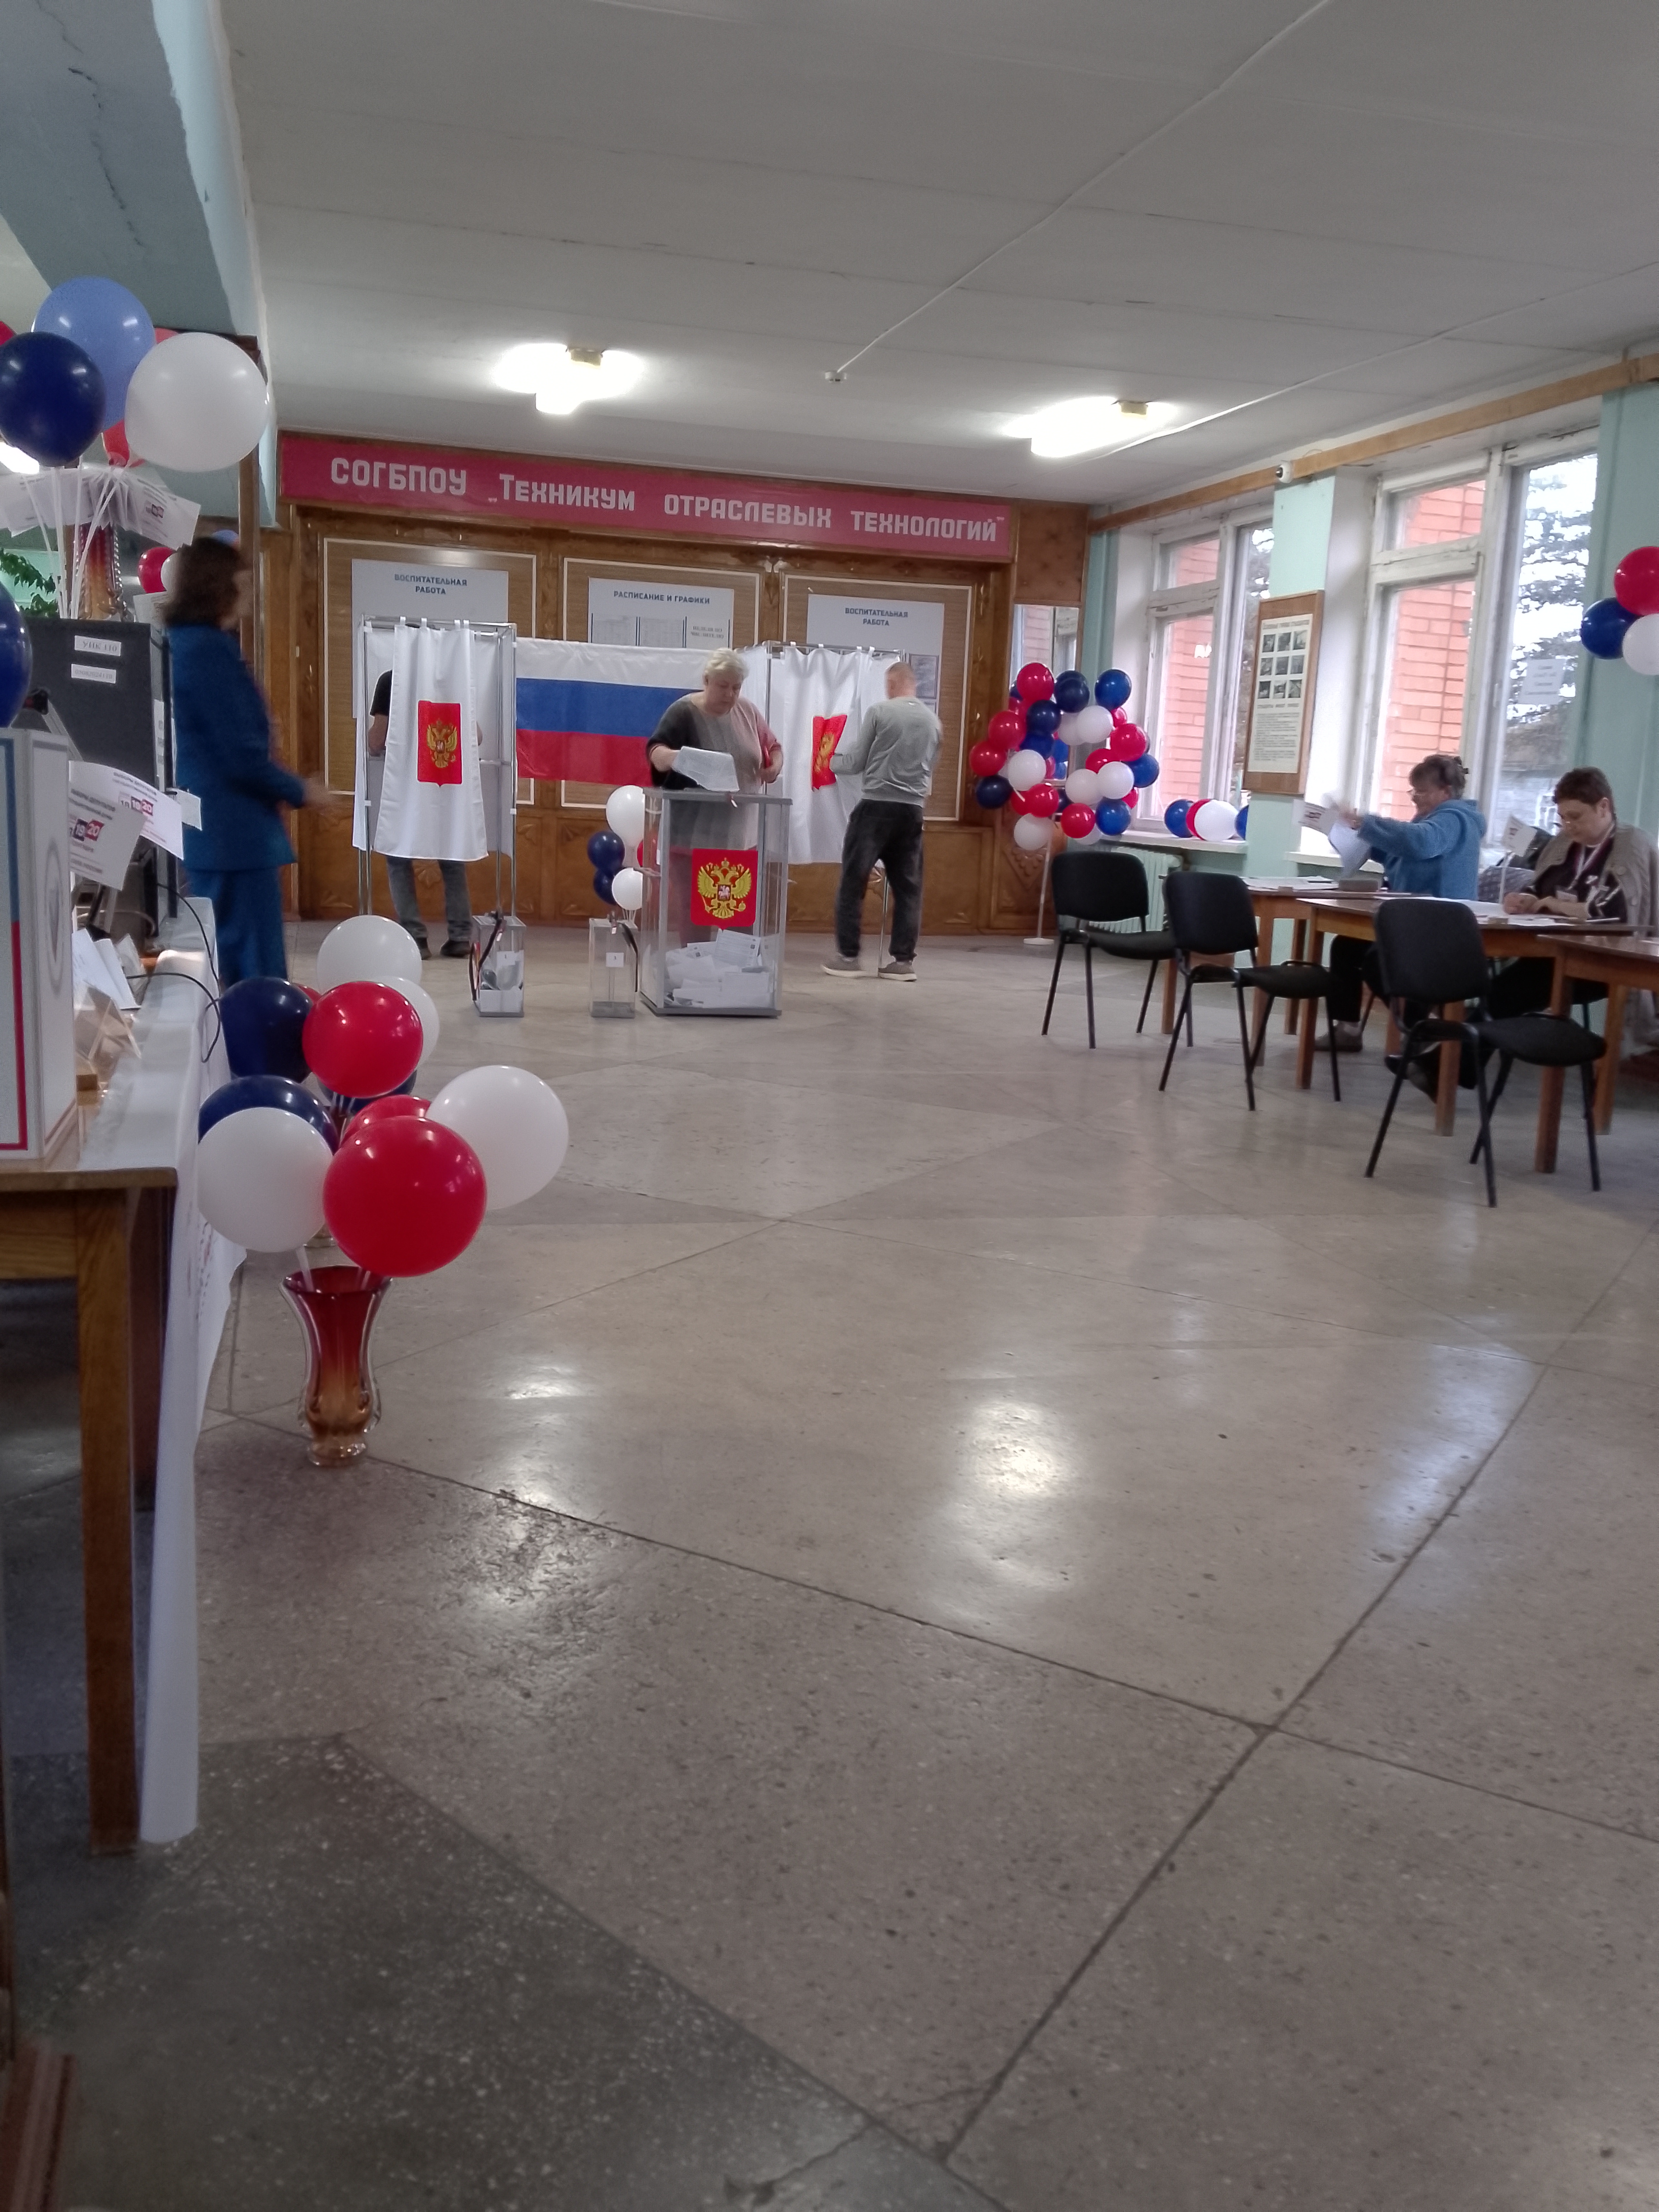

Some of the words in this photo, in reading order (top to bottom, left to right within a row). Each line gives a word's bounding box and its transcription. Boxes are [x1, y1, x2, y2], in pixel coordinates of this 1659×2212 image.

[331, 457, 466, 496] СОГБПОУ
[664, 493, 831, 529] ОТРАСЛЕВЫХ
[394, 574, 467, 586] ВОСПИТАТЕЛЬНАЯ
[415, 586, 446, 595] РАБОТА
[613, 590, 664, 601] РАСПИСАНИЕ
[674, 595, 710, 604] ГРАФИКИ
[845, 607, 908, 618] ВОСПИТАТЕЛЬНАЯ
[863, 618, 890, 626] РАБОТА
